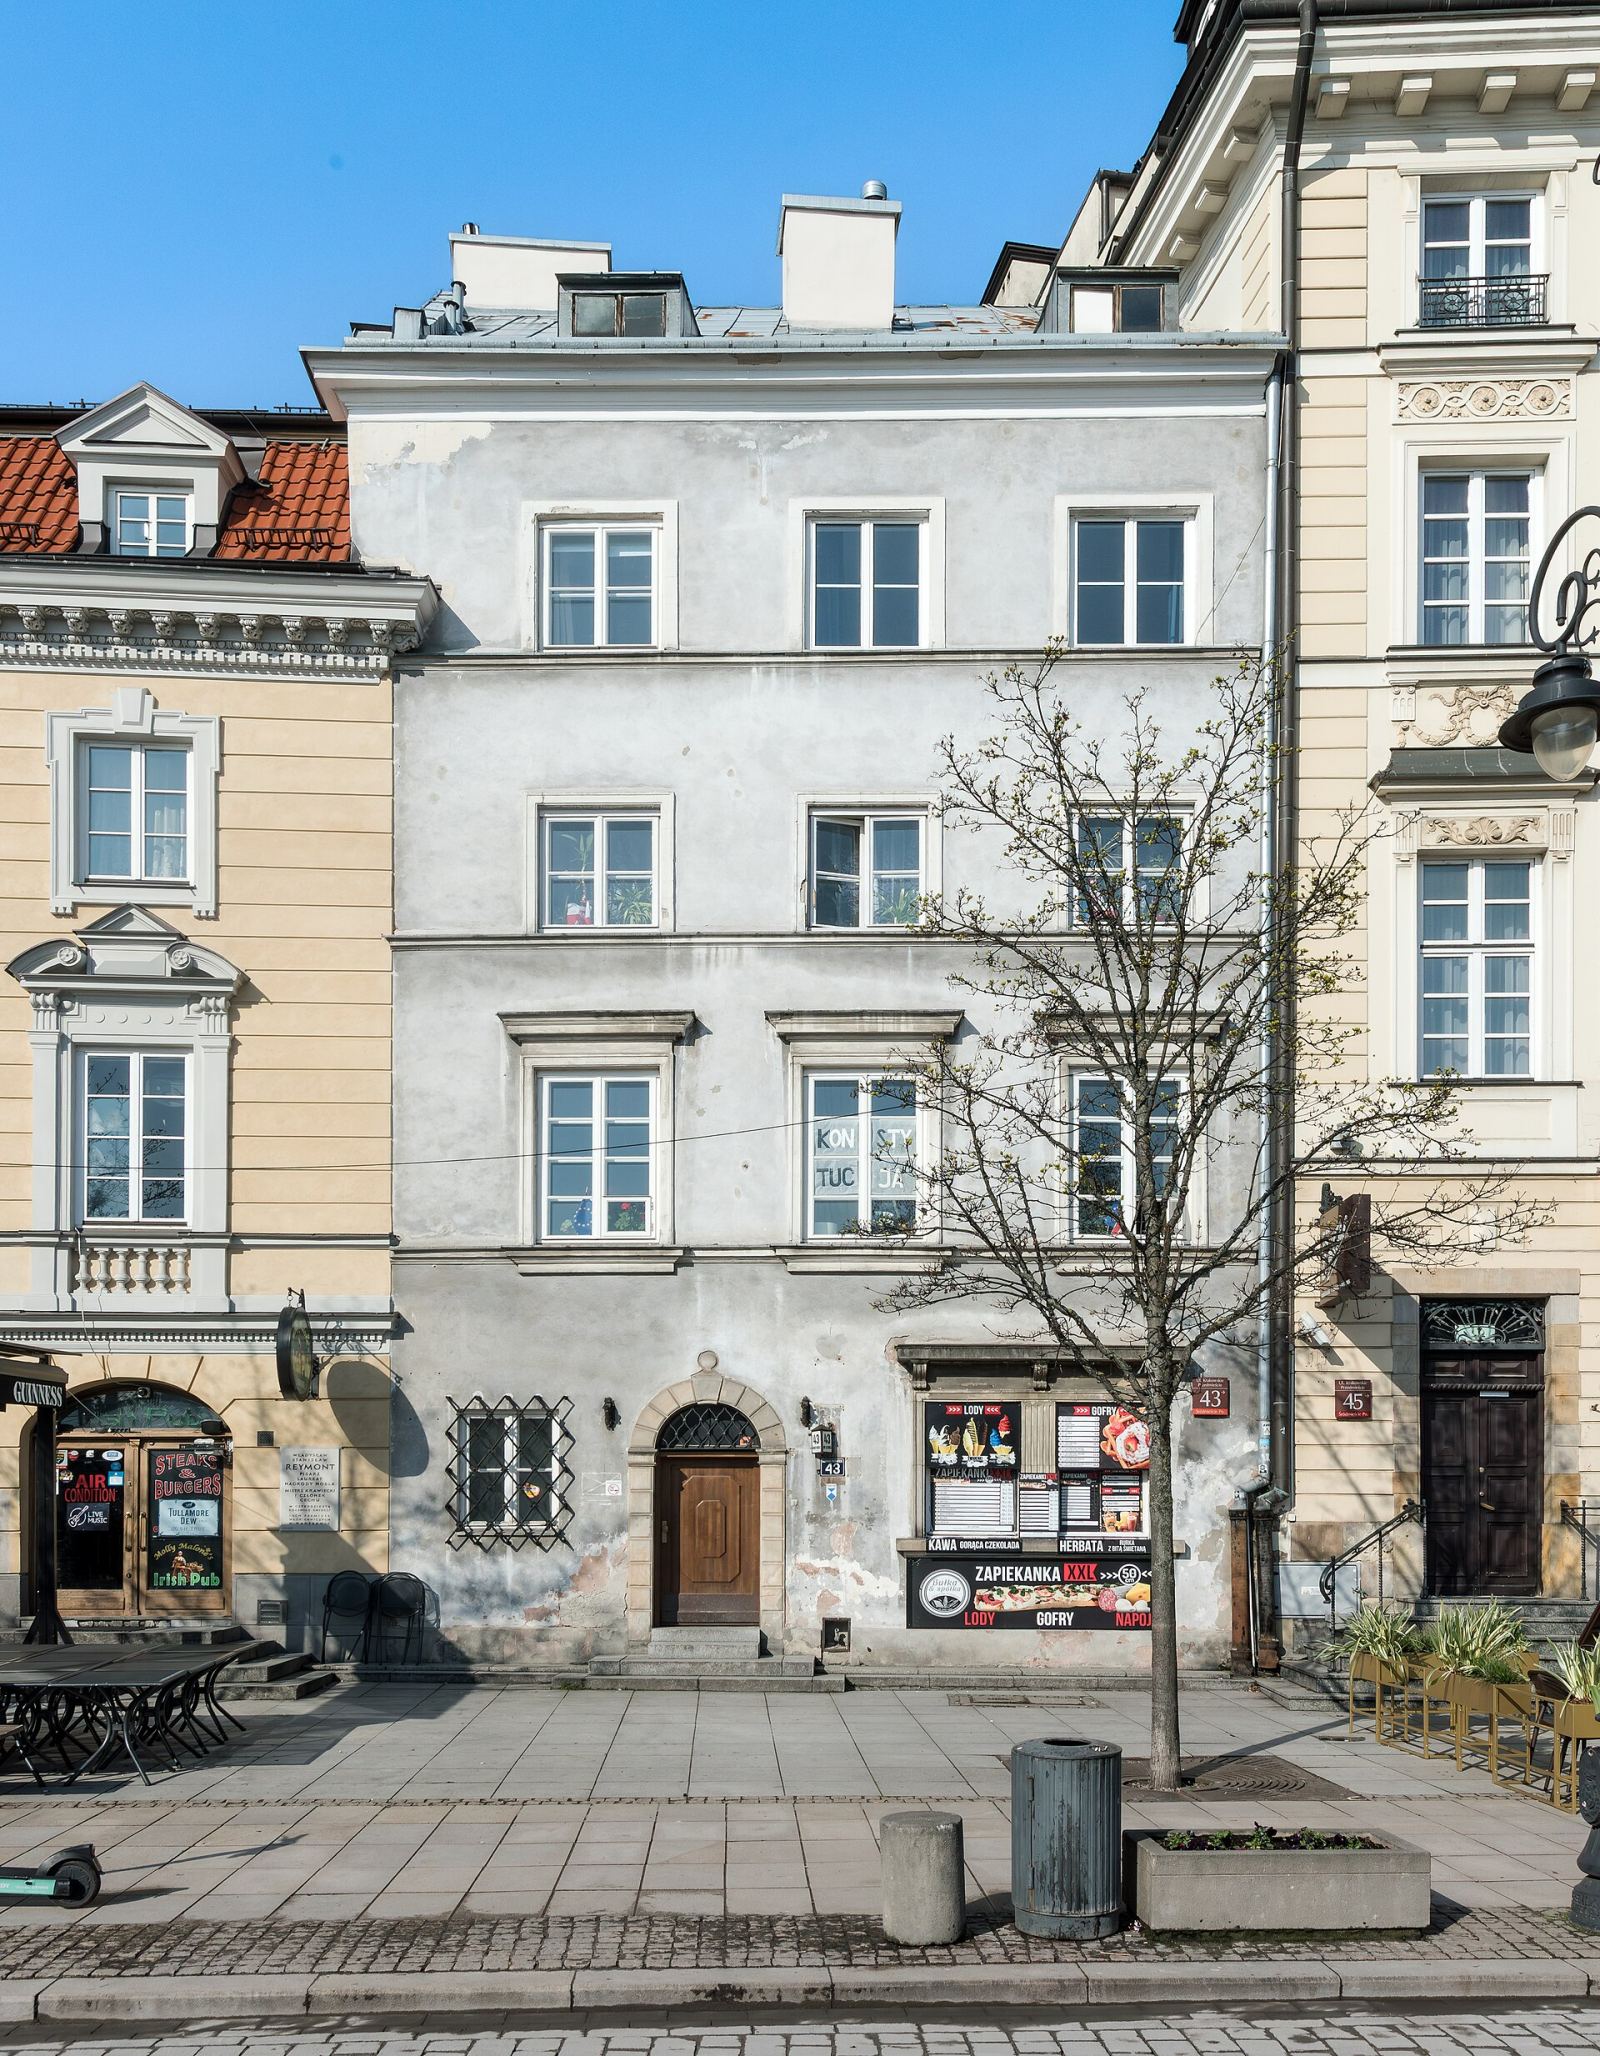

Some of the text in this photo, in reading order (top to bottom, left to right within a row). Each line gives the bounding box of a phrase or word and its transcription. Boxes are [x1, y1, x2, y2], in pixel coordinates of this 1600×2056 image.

[817, 1128, 912, 1149] KON STY
[816, 1166, 904, 1189] TUC JA
[13, 1381, 63, 1408] GUINNESS
[1199, 1390, 1222, 1408] 43
[1342, 1392, 1364, 1410] 45
[963, 1405, 984, 1415] LODY
[1091, 1406, 1117, 1416] GOFRY
[813, 1434, 820, 1444] 43
[824, 1434, 831, 1444] 43
[155, 1453, 217, 1476] STEAKS
[825, 1463, 840, 1475] 43
[179, 1468, 196, 1479] &
[75, 1474, 106, 1489] AIR
[154, 1473, 222, 1500] BURGERS
[64, 1488, 116, 1503] CONDITION
[168, 1508, 209, 1517] TULLAMORE
[180, 1517, 197, 1525] DEW
[153, 1543, 177, 1561] Molly
[928, 1539, 1020, 1551] KAWA GORĄCA CZEKOLADA
[1059, 1540, 1104, 1552] HERBATA
[153, 1572, 220, 1587] Irish Pub
[975, 1565, 1095, 1582] ZAPIEKANKA XXL
[1121, 1568, 1137, 1579] 50
[964, 1612, 996, 1627] LODY
[1036, 1611, 1074, 1627] GOFRY
